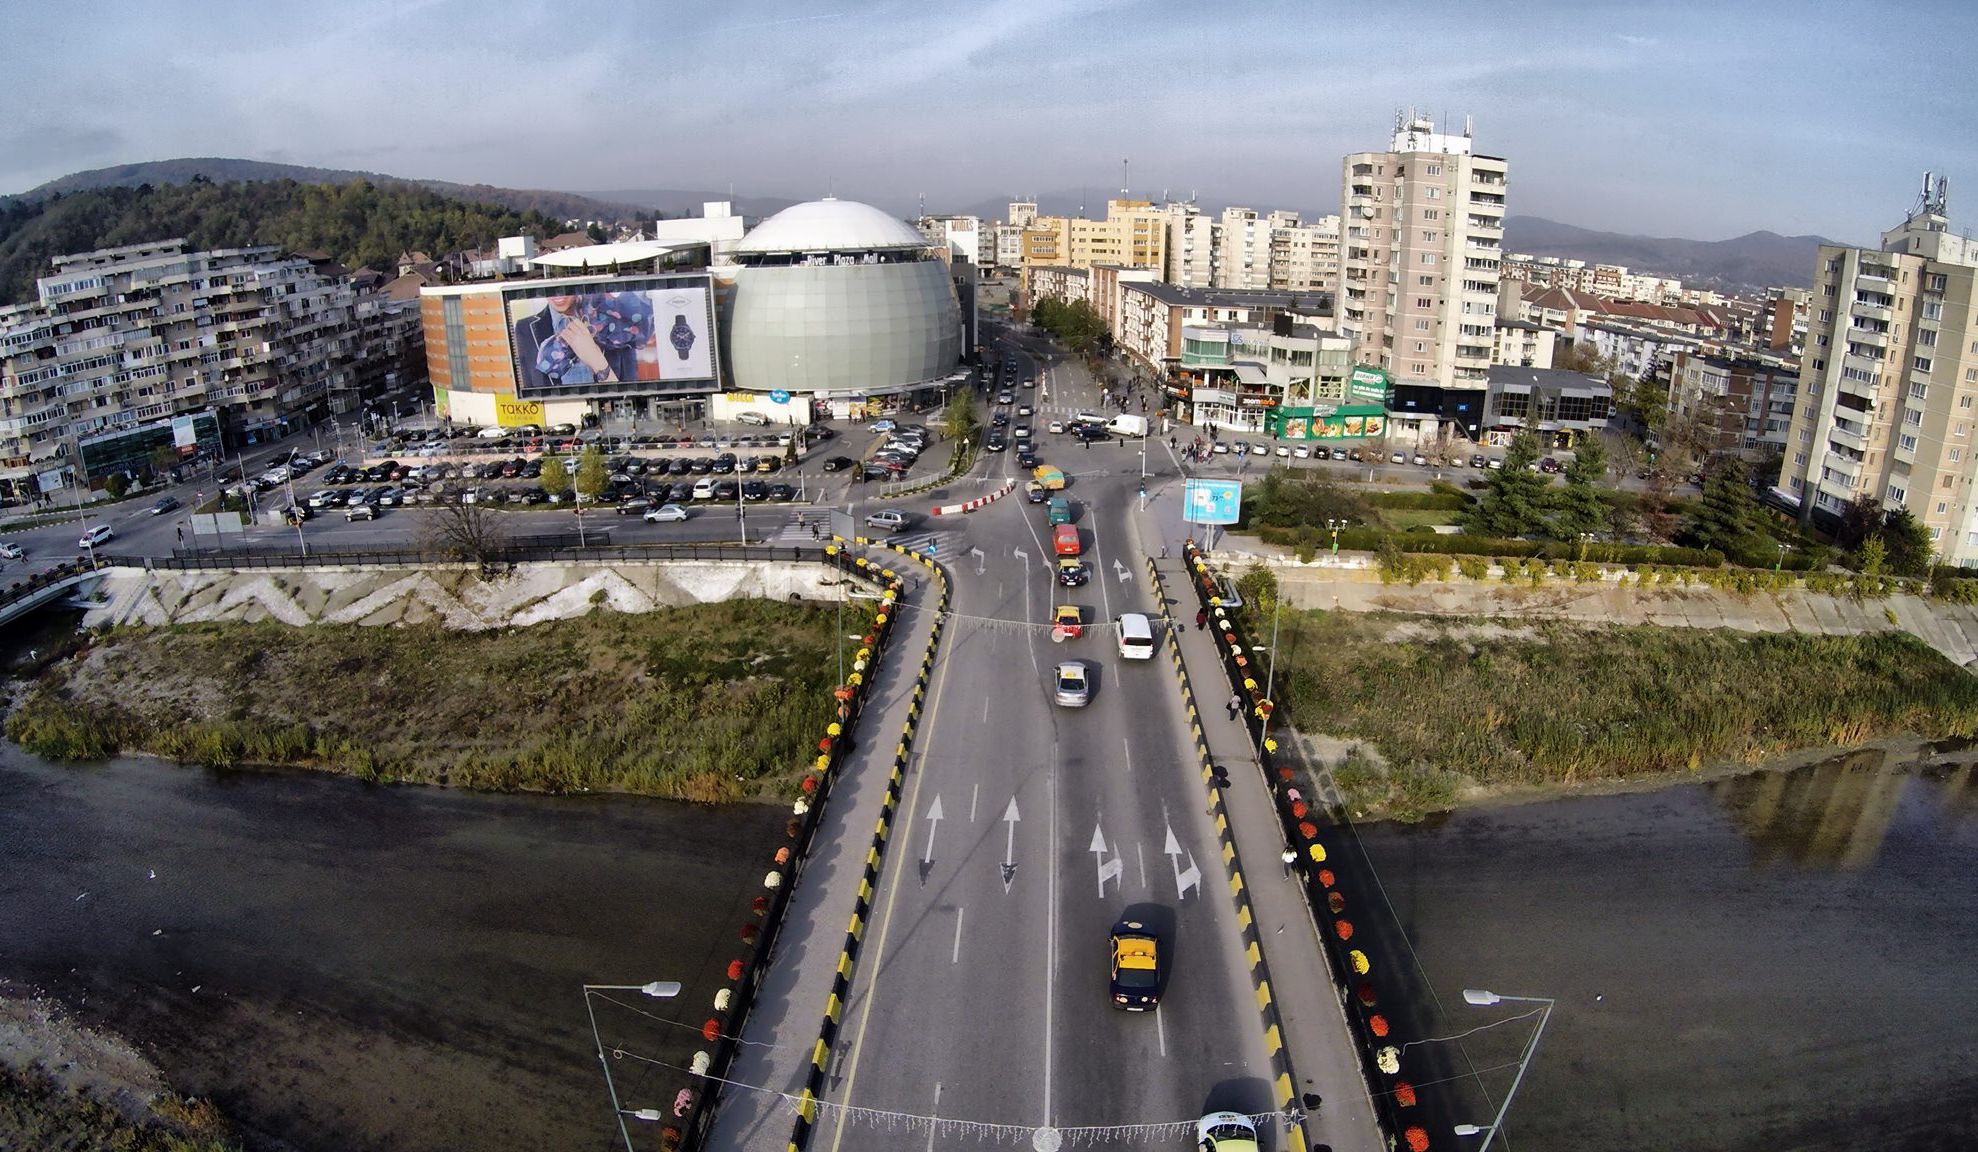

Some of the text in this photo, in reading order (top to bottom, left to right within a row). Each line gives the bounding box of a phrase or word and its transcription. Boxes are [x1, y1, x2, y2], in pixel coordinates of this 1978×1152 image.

[807, 253, 877, 266] River Plaza Mall
